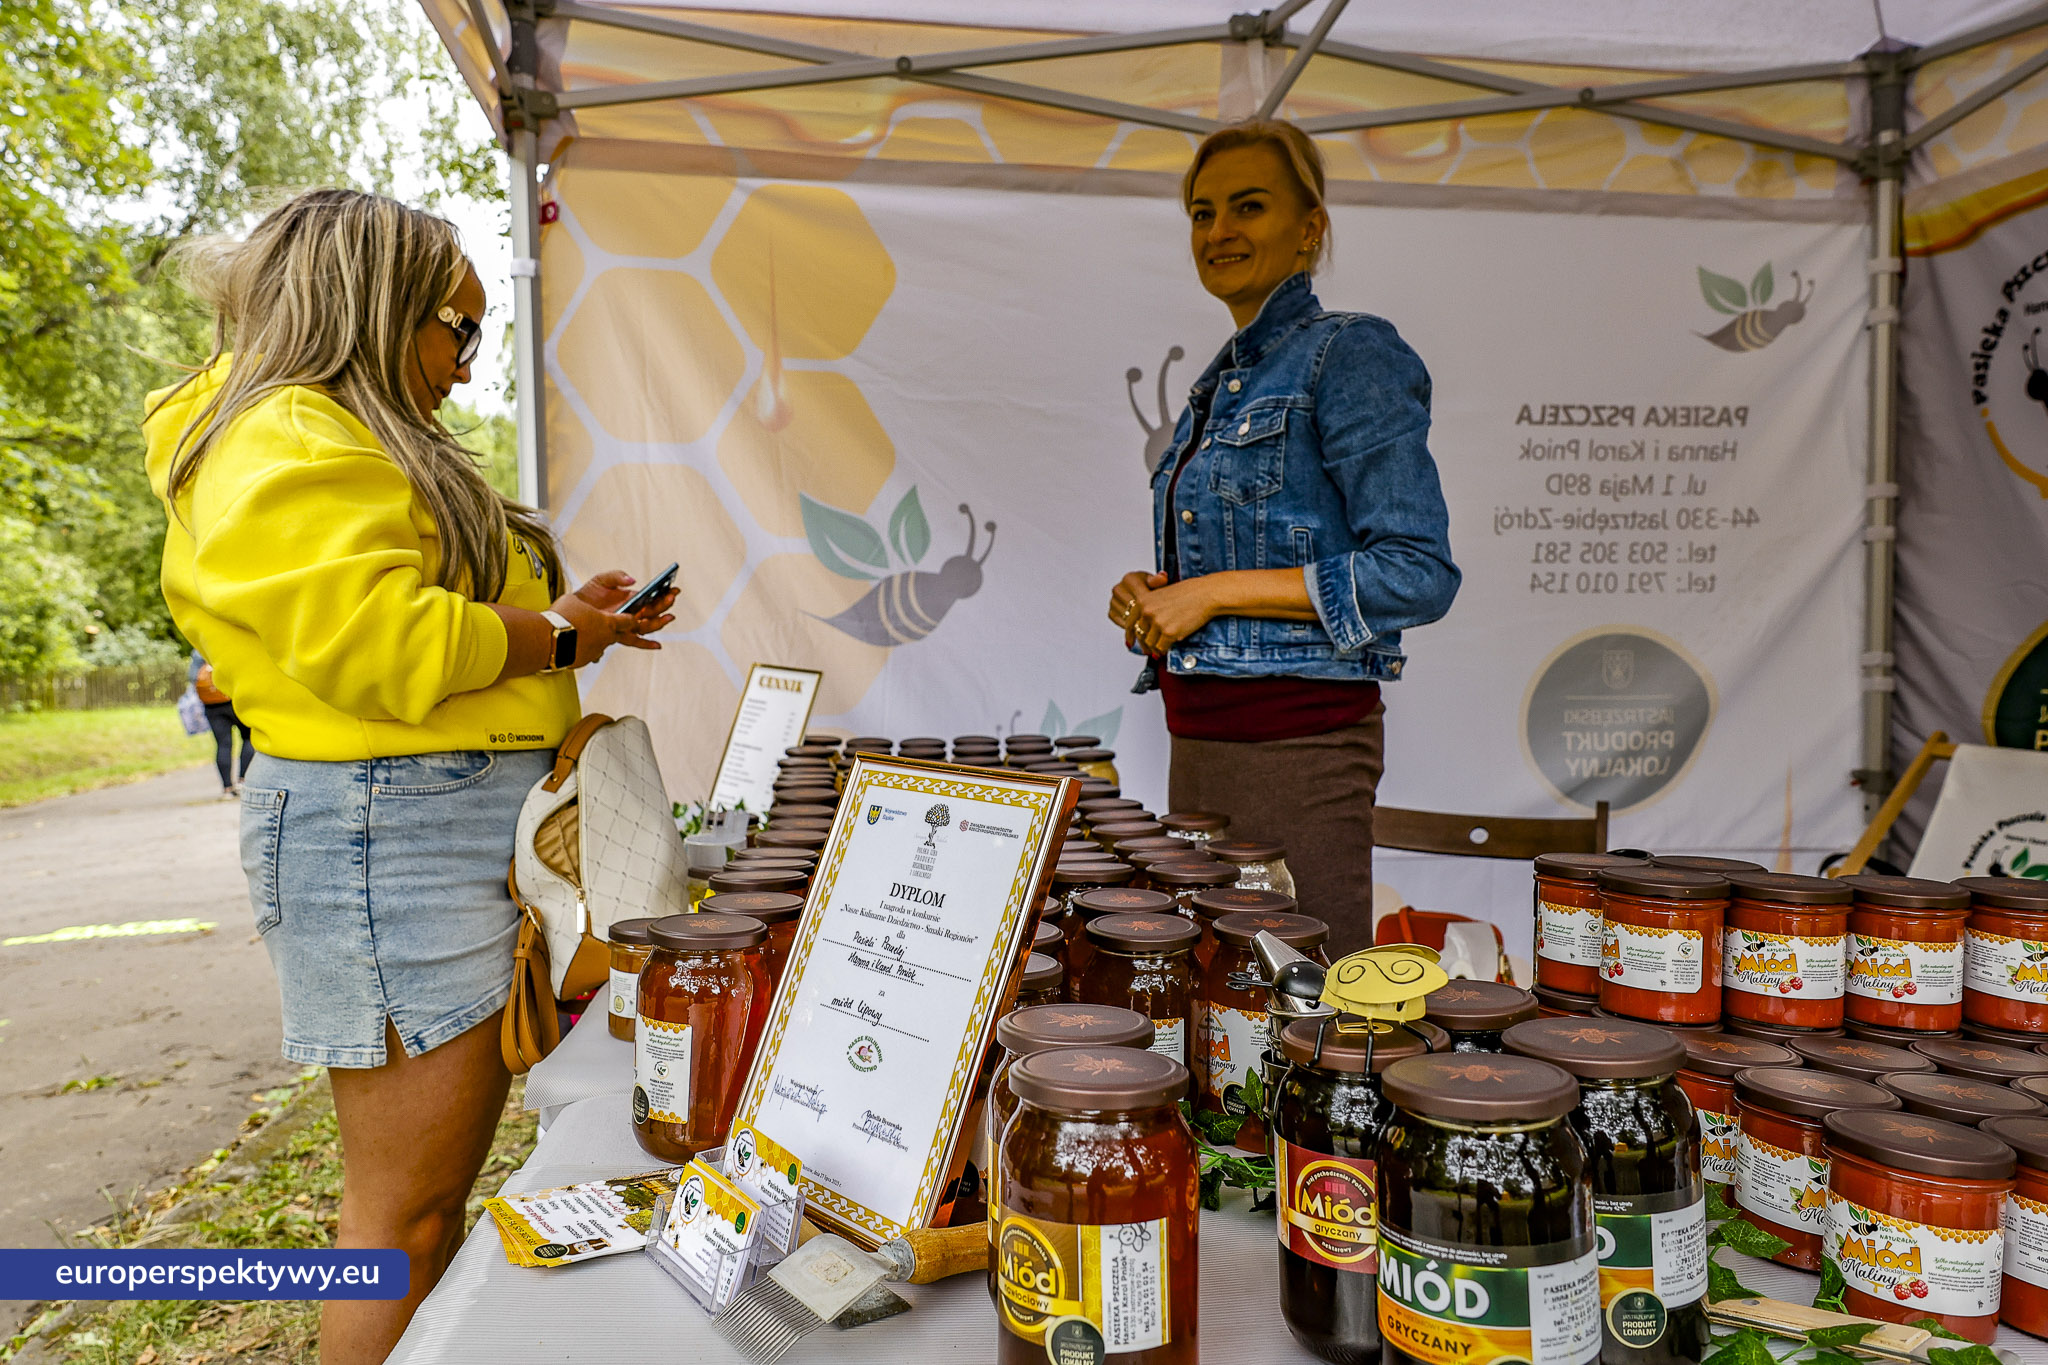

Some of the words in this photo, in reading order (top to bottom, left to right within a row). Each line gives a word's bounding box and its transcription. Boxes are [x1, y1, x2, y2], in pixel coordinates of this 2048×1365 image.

[1970, 307, 2011, 406] Pasieka
[2002, 249, 2048, 303] Pszc
[758, 675, 804, 693] CENNIK
[889, 882, 946, 908] DYPLOM
[859, 907, 886, 922] Kulinarne
[887, 914, 921, 930] Dziedzictwo
[925, 925, 944, 938] Smaki
[883, 903, 906, 914] nagroda
[912, 908, 941, 923] konkursie
[896, 930, 906, 939] dla
[1740, 952, 1798, 973] Miód
[1852, 956, 1912, 978] Miód
[2016, 962, 2048, 983] Mi
[1739, 971, 1782, 988] Maliny
[1852, 974, 1896, 992] Maliny
[2015, 981, 2048, 994] Mal
[1703, 1135, 1738, 1161] Mi
[1702, 1156, 1736, 1172] Mali
[1351, 1179, 1368, 1197] Polska
[1301, 1188, 1376, 1226] Miód
[1314, 1223, 1362, 1241] gryczany
[1880, 1234, 1918, 1244] NATURALNY
[1842, 1232, 1922, 1274] Miód
[1001, 1247, 1056, 1294] Miód
[1842, 1259, 1899, 1289] Maliny
[1379, 1248, 1490, 1319] MIÓD
[1113, 1305, 1121, 1346] PASIEKA
[1623, 1320, 1656, 1329] PRODUKT
[1623, 1328, 1656, 1337] LOKALNY
[1387, 1315, 1472, 1356] GRYCZANY
[1060, 1349, 1095, 1360] PRODUKT
